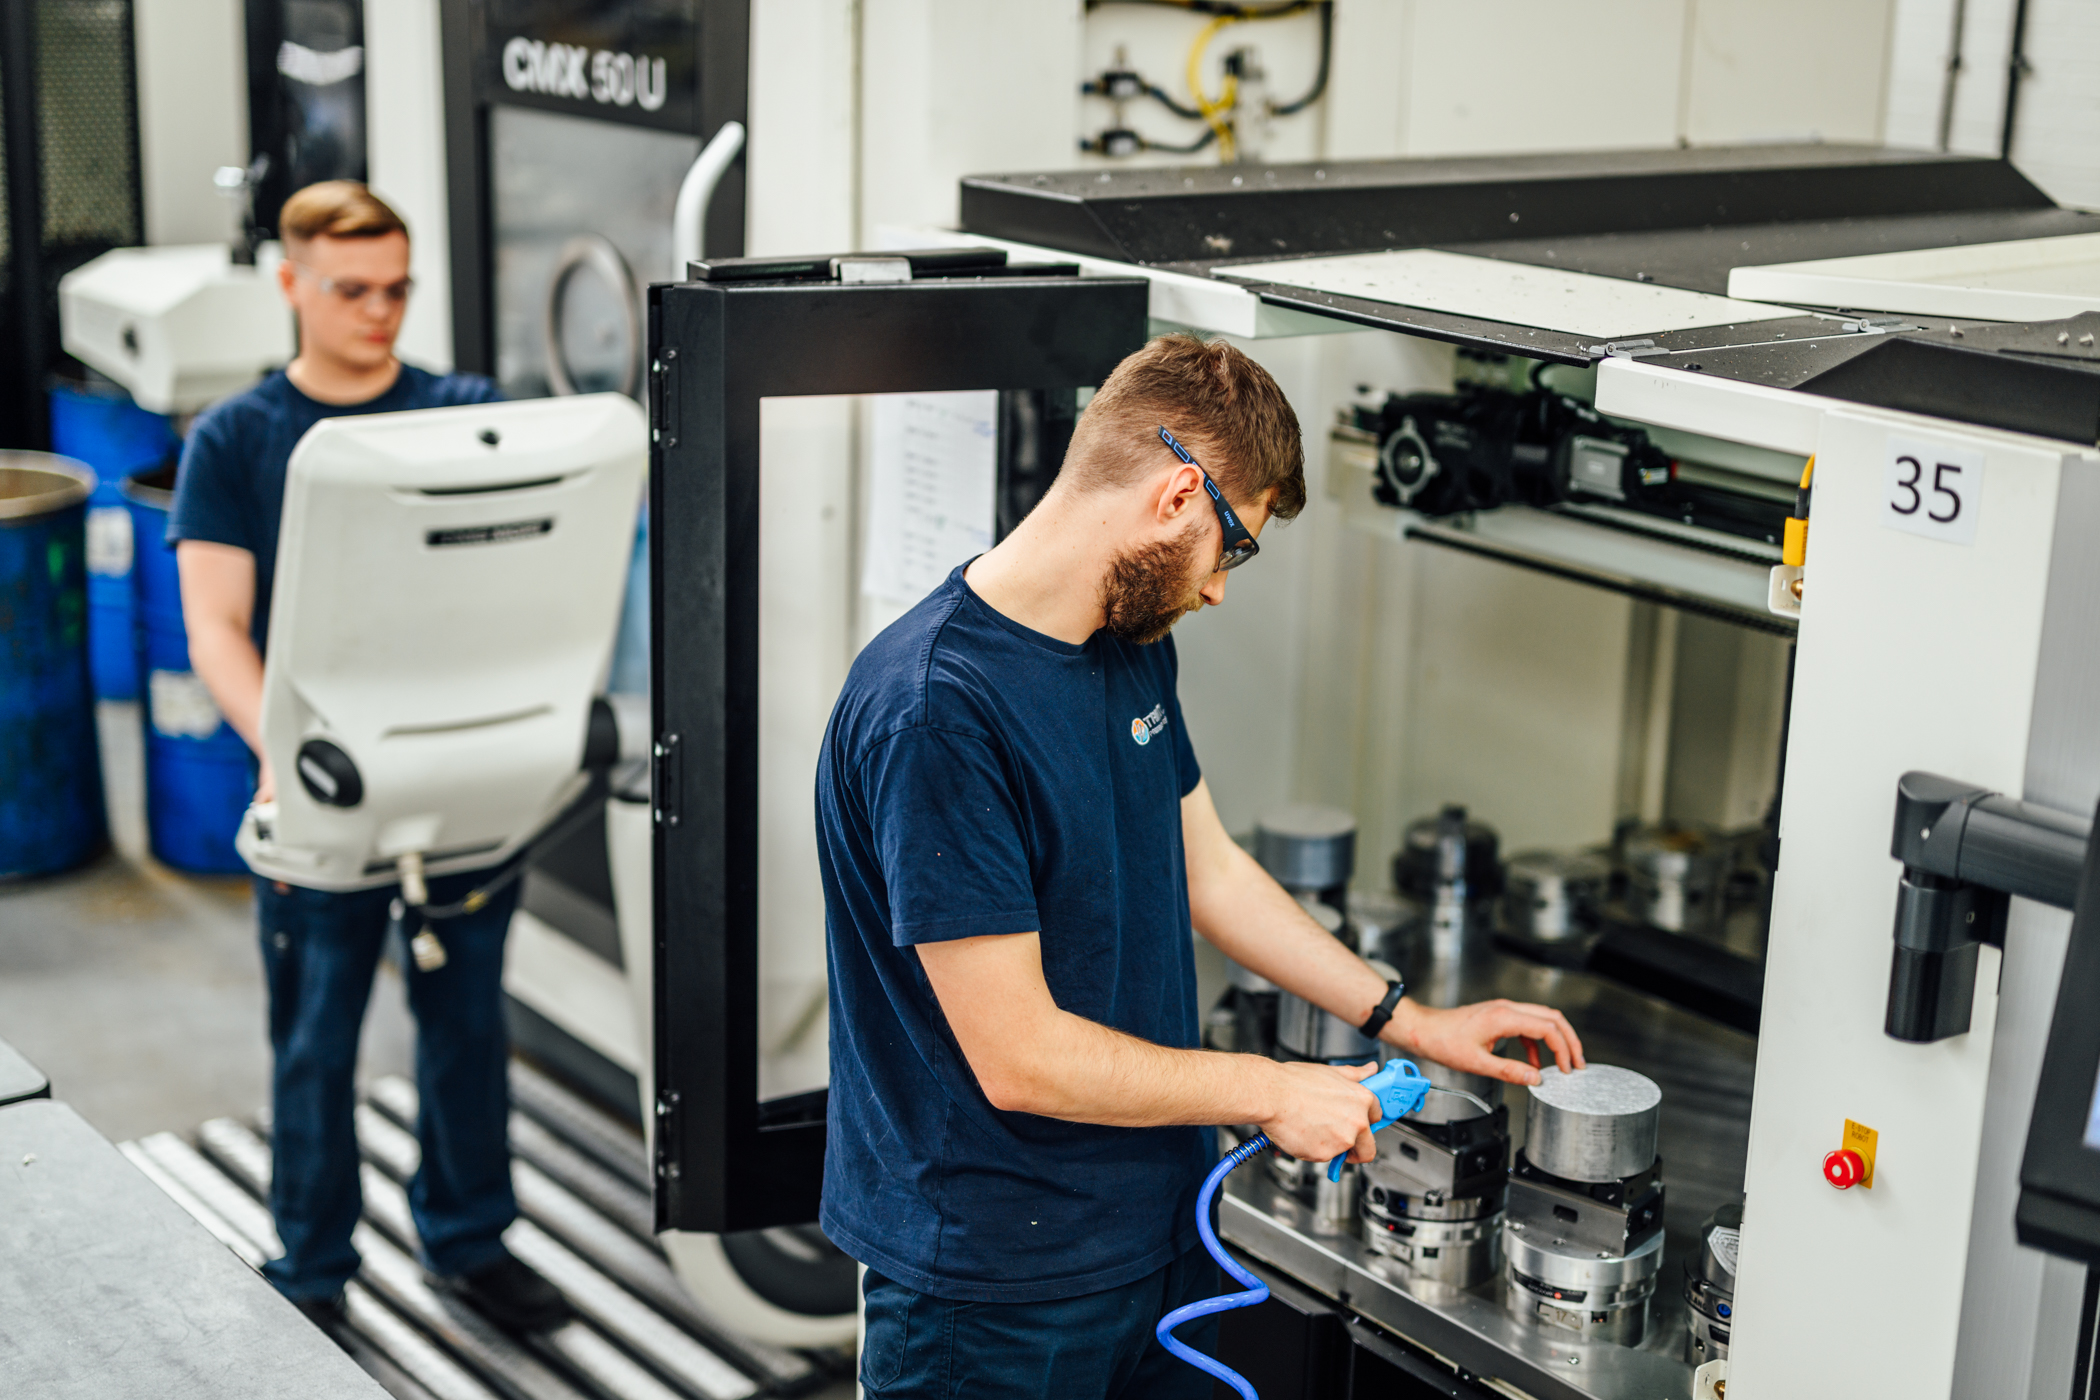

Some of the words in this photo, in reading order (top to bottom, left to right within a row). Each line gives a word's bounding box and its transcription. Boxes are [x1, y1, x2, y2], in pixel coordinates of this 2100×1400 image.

[502, 36, 589, 99] CMX
[591, 49, 635, 107] 50
[636, 54, 667, 111] U
[1891, 456, 1962, 523] 35
[1224, 510, 1235, 527] uvex
[1851, 1121, 1871, 1135] E-STOP
[1851, 1130, 1869, 1144] ROBOT
